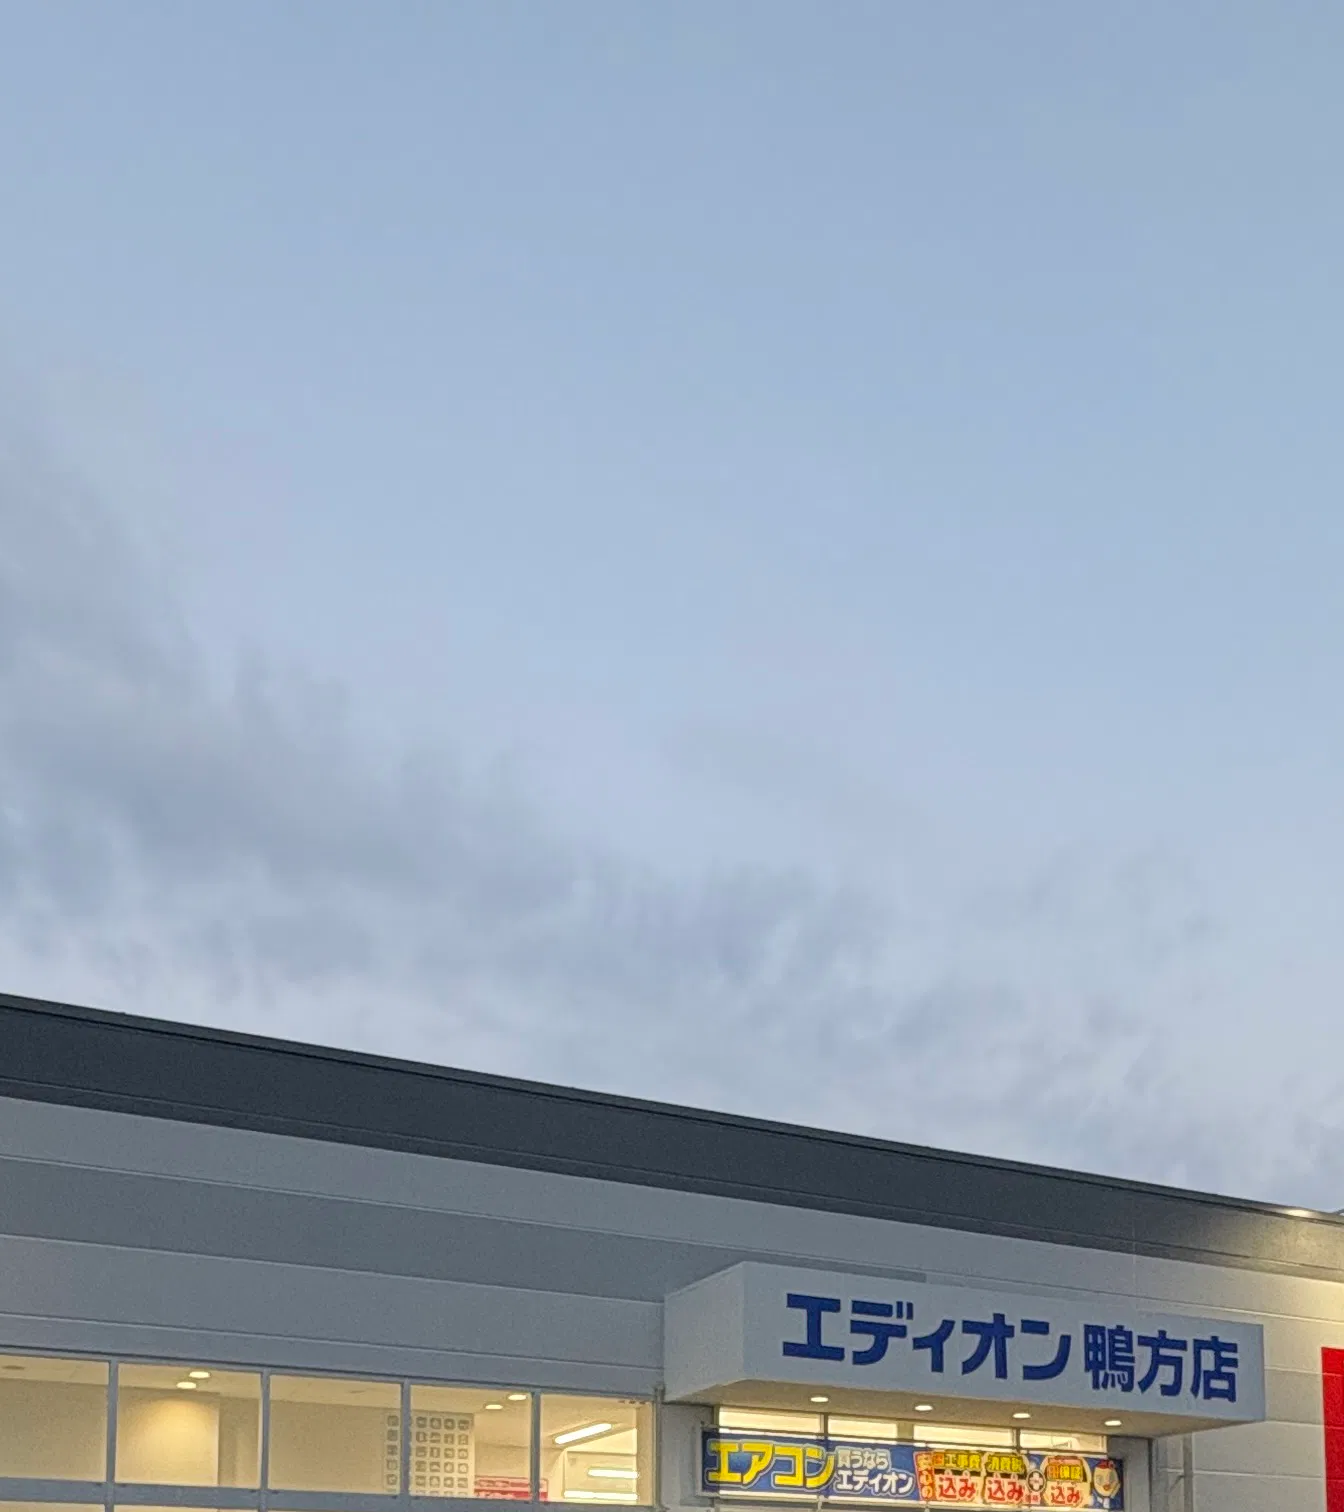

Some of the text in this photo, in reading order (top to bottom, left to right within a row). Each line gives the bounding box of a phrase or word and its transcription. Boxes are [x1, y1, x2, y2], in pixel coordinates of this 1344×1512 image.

[782, 1293, 1239, 1402] エディオン鴨方店
[708, 1441, 835, 1488] エアコン
[836, 1471, 913, 1494] エディオン
[938, 1476, 976, 1499] 込み
[987, 1479, 1024, 1501] 込み
[1051, 1486, 1080, 1504] 込み
